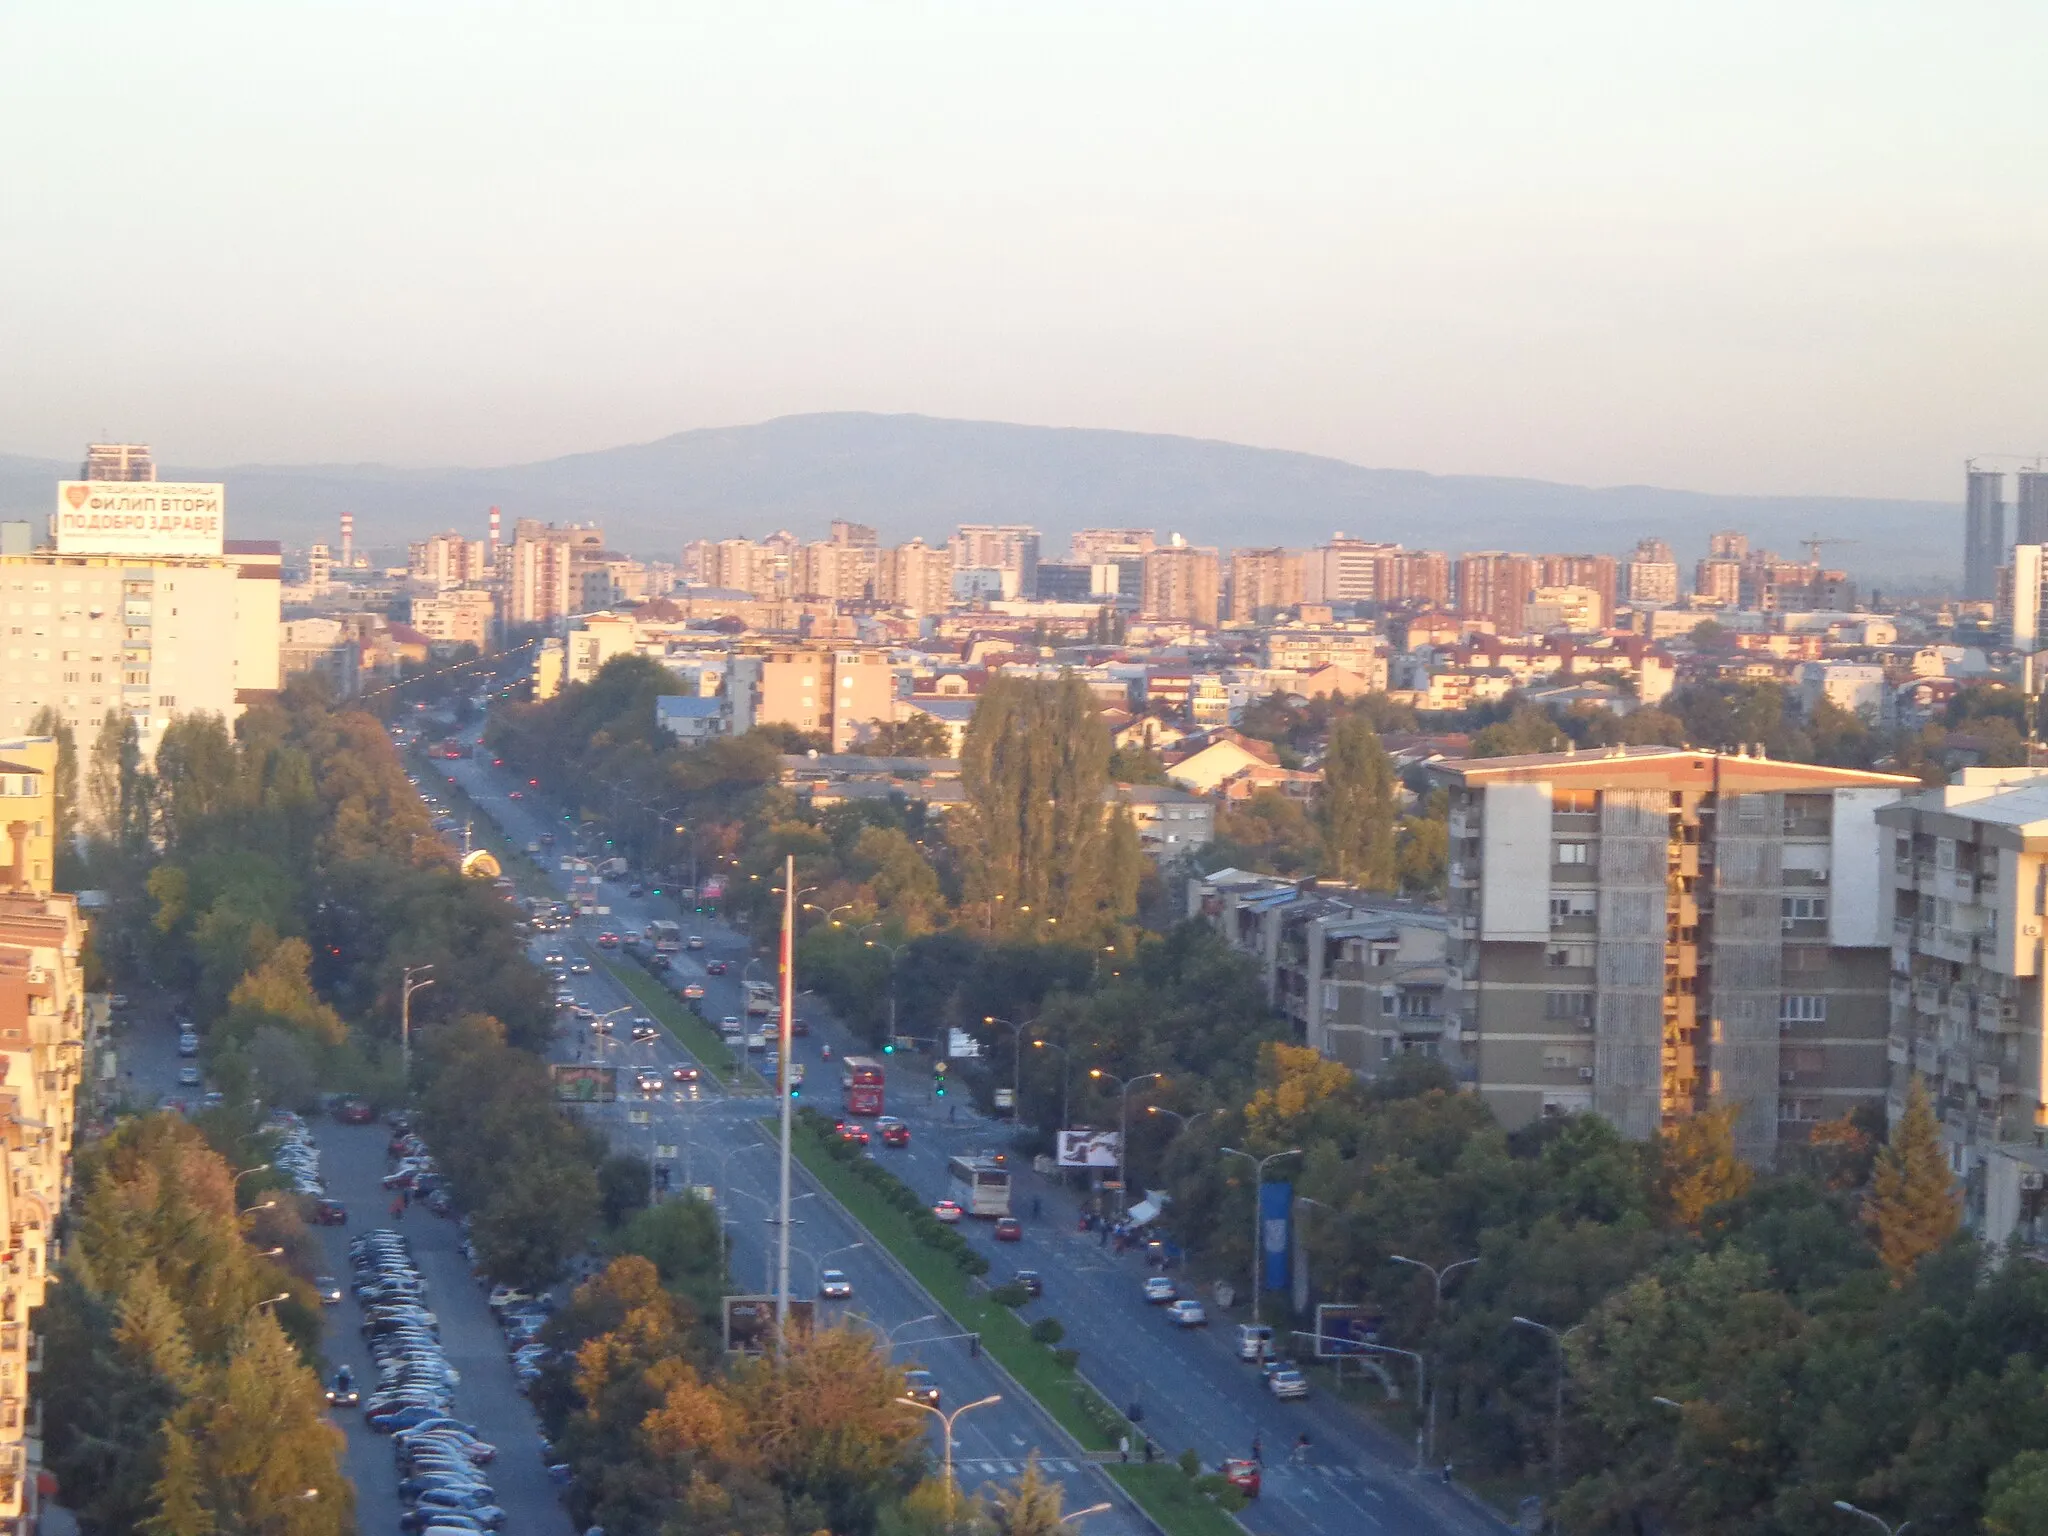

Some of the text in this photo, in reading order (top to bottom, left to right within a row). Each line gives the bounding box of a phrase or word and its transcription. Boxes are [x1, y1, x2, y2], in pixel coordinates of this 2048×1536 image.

[90, 498, 218, 512] ФИЛИП ВТОРИ
[63, 514, 218, 534] ПОДОБРО ЗДРАВЈЕ
